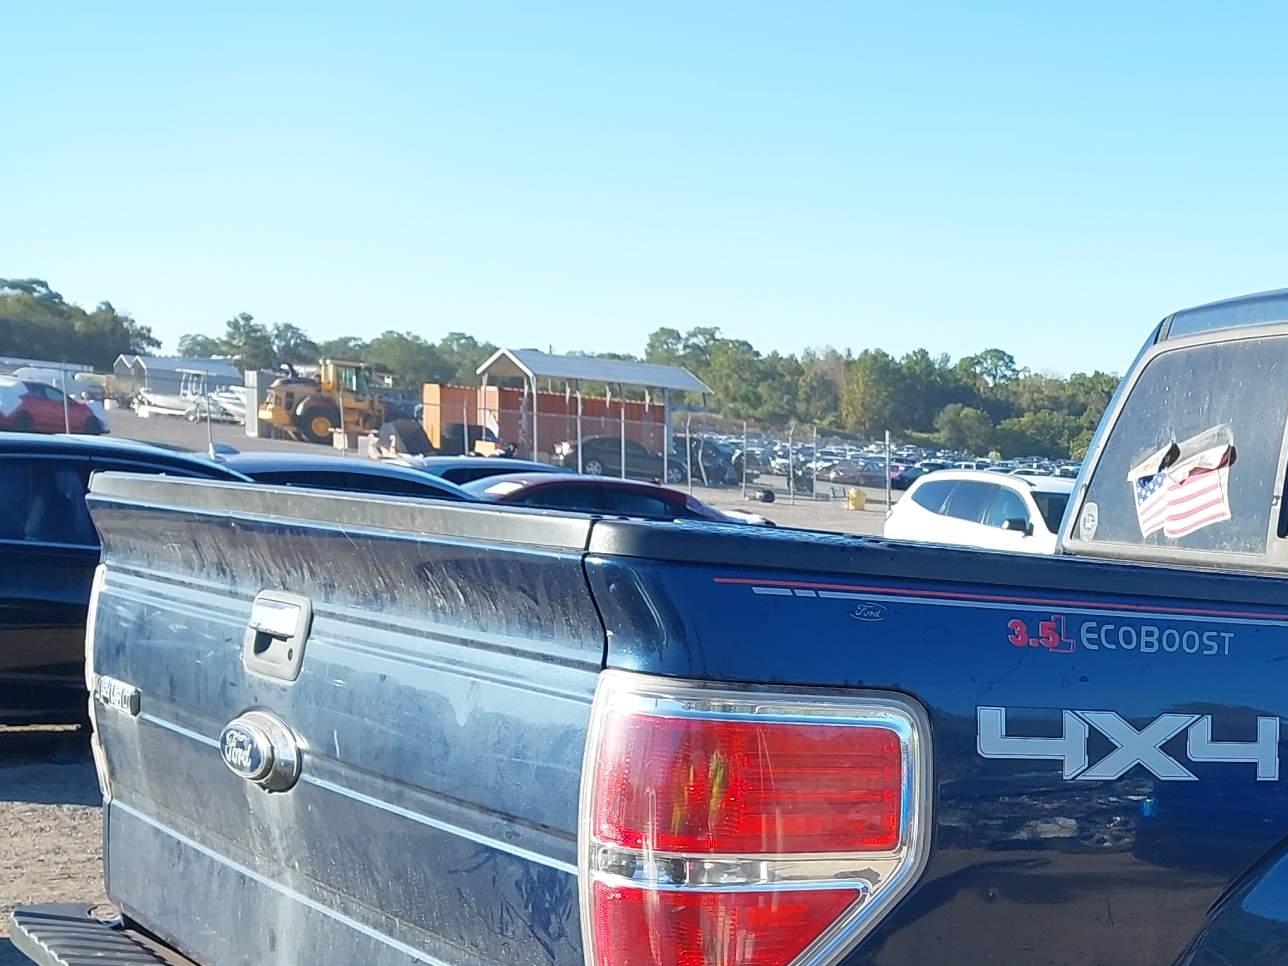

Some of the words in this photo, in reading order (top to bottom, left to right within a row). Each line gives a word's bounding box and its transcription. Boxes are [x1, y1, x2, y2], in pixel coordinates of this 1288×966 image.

[855, 604, 881, 618] Ford
[1080, 621, 1235, 656] ECOBOOST
[225, 730, 252, 768] Ford
